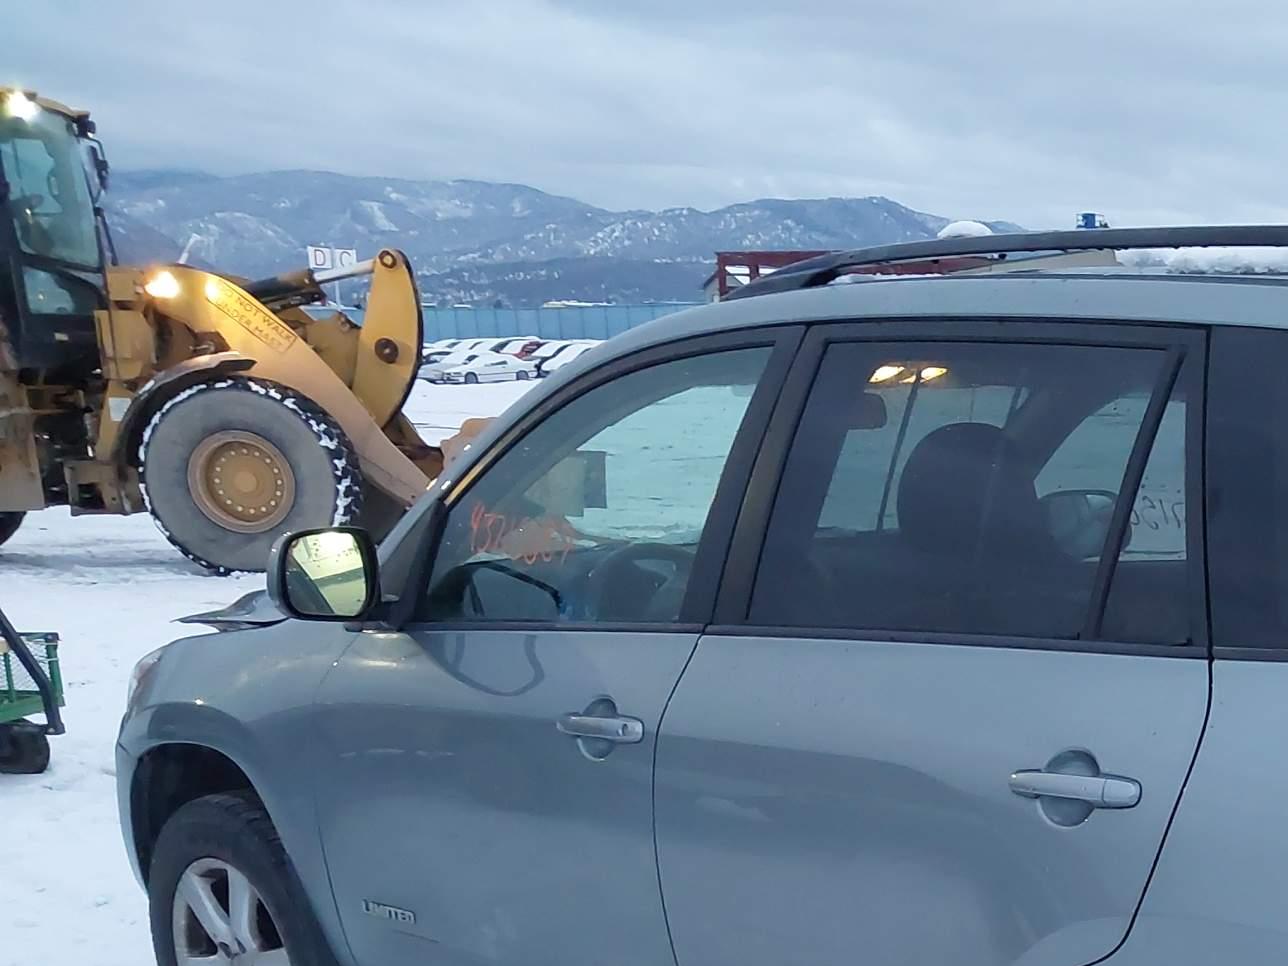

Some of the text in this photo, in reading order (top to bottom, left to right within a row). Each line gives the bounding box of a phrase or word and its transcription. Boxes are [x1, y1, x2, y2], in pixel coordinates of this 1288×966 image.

[313, 248, 326, 266] D
[236, 297, 260, 317] NOT
[263, 316, 293, 342] WALK
[362, 898, 416, 924] LIMITED
